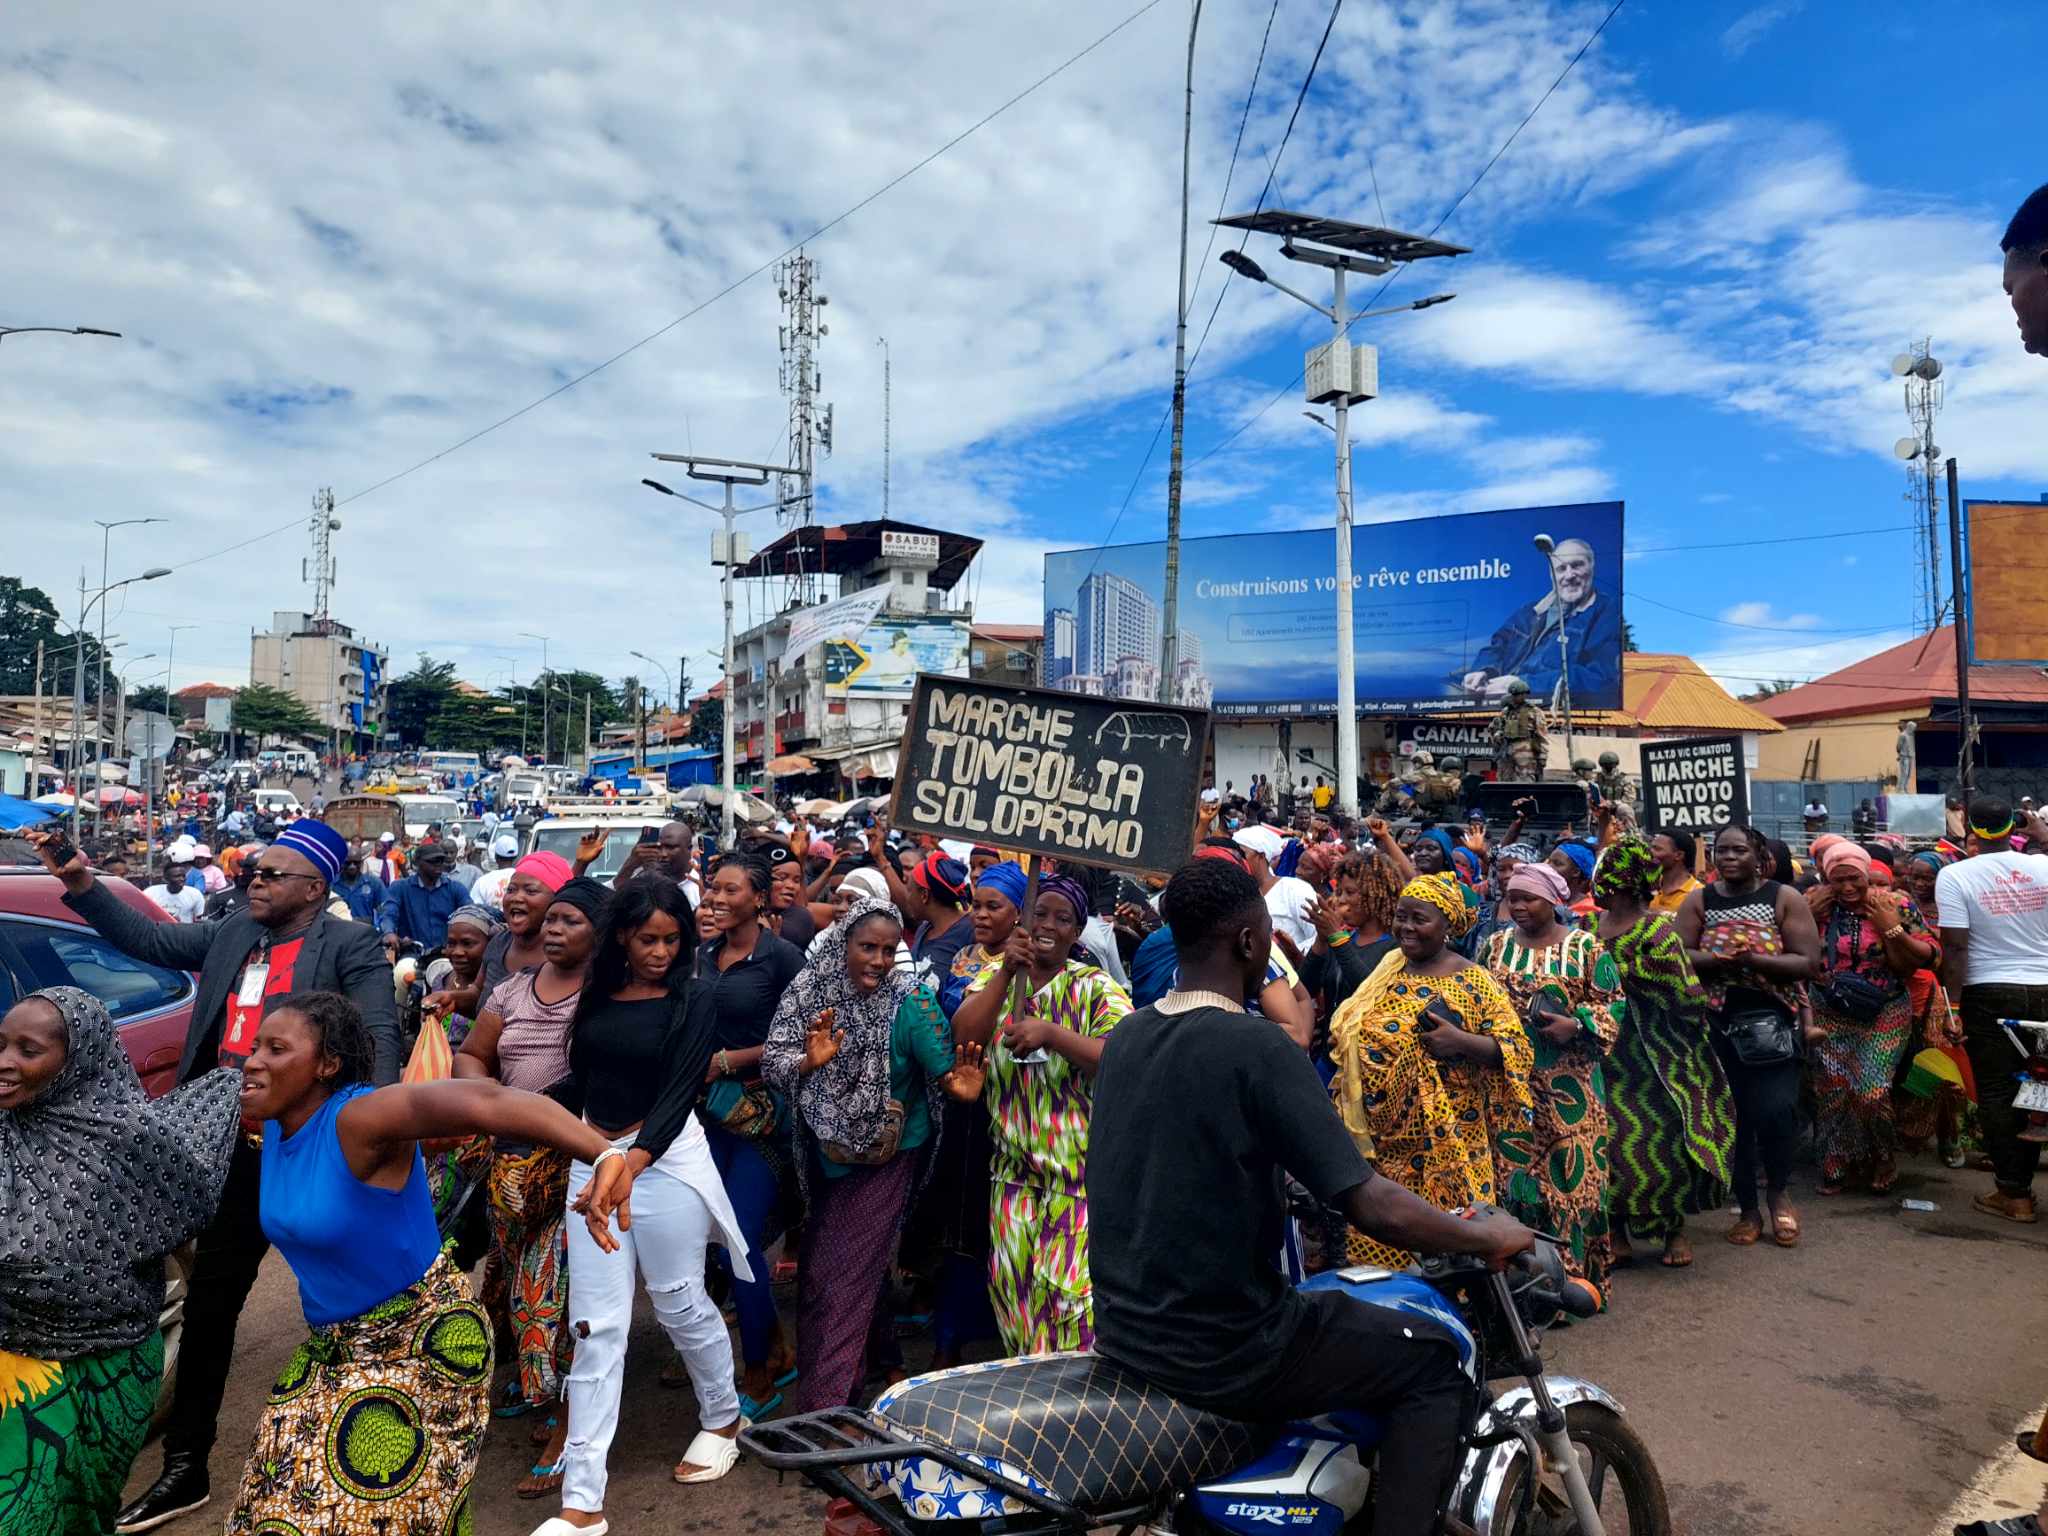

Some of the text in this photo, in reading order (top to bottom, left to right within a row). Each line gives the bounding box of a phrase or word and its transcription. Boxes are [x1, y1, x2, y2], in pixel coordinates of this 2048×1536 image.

[895, 534, 937, 546] SABUS
[1195, 557, 1511, 599] Construisons voe rêve ensemble
[927, 687, 1075, 749] MARCHE
[1412, 725, 1490, 744] CANAL+
[926, 728, 1144, 815] TOMBOLIA
[1651, 756, 1736, 783] MARCHE
[337, 800, 388, 809] POLICE
[1656, 780, 1733, 805] MATOTO
[912, 779, 1144, 859] SOLOPRIMO
[1659, 803, 1731, 827] PARC
[1286, 1507, 1320, 1516] HLX
[1291, 1516, 1314, 1524] 125
